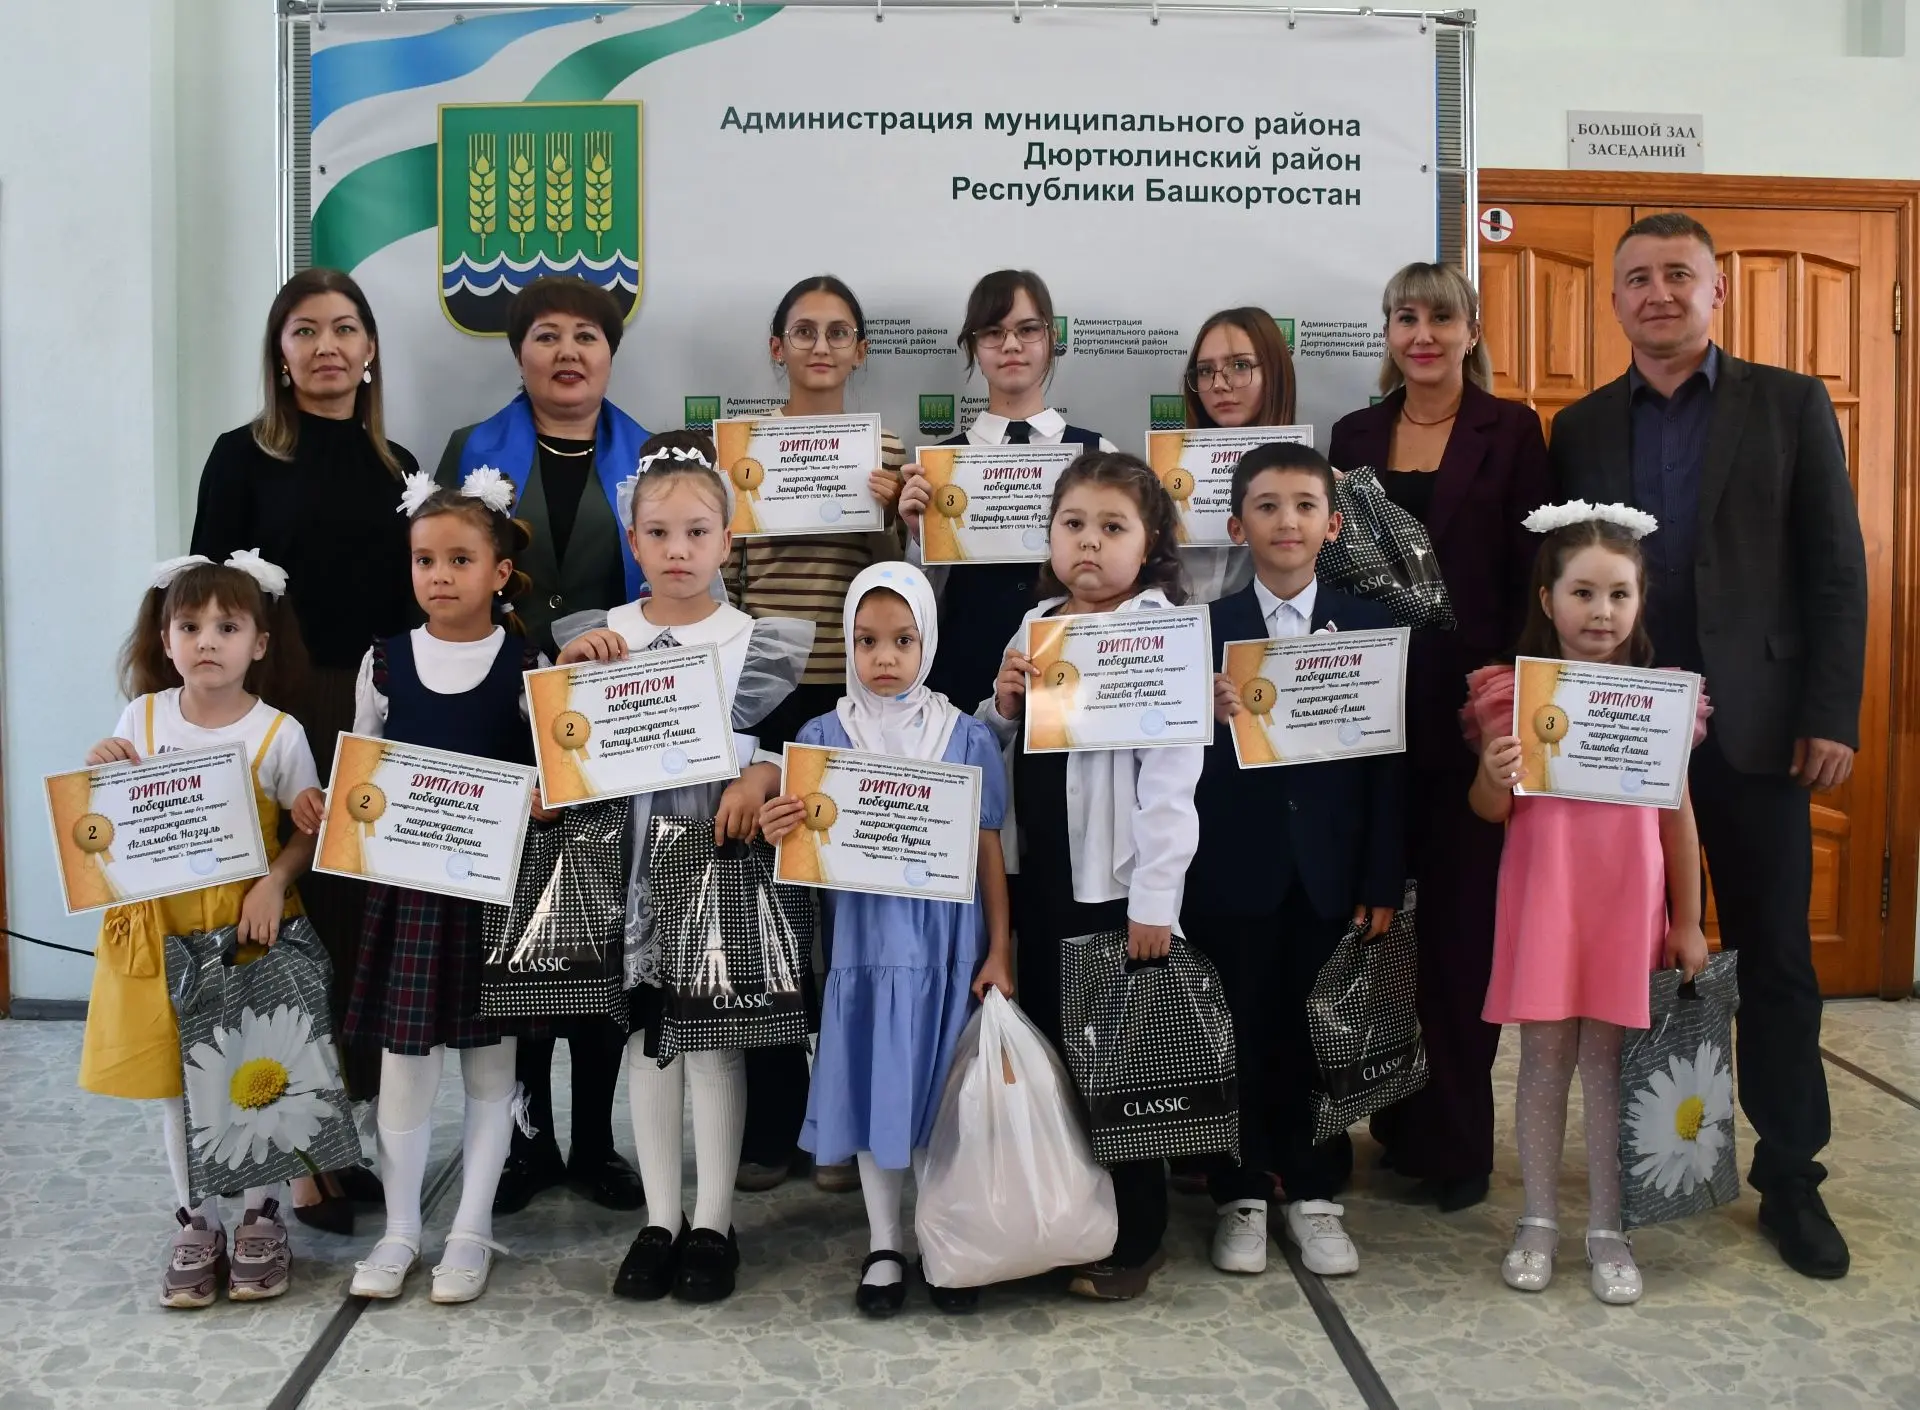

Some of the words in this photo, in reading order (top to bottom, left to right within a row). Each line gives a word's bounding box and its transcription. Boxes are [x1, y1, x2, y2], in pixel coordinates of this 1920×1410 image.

[720, 106, 972, 135] Администрация
[984, 112, 1244, 136] муниципального
[1255, 111, 1361, 139] района
[1578, 123, 1661, 137] БОЛЬШОЙ
[1667, 126, 1696, 138] ЗАЛ
[1024, 141, 1261, 171] Дюртюлинский
[1273, 146, 1361, 174] район
[1588, 143, 1686, 158] ЗАСЕДАНИЙ
[952, 176, 1134, 206] Республики
[1146, 178, 1361, 209] Башкортостан
[1073, 318, 1143, 326] Администрация
[1301, 320, 1368, 329] Администрация
[1149, 328, 1179, 337] района
[910, 337, 936, 346] район
[1073, 338, 1139, 346] Дюртюлинский
[1142, 338, 1168, 346] район
[1300, 339, 1365, 348] Дюртюлинский
[895, 347, 957, 356] Башкортостан
[1073, 347, 1124, 356] Республики
[1126, 348, 1188, 356] Башкортостан
[1301, 350, 1350, 358] Республики
[1352, 350, 1383, 358] Башкор
[779, 438, 840, 452] ДИПЛОМ
[781, 454, 839, 465] победителя
[1211, 451, 1242, 463] ДИП
[745, 468, 750, 479] 1
[783, 475, 839, 484] награждается
[983, 467, 1042, 480] ДИПЛОМ
[984, 482, 1042, 493] победителя
[1174, 478, 1181, 489] 3
[947, 495, 955, 507] 3
[1097, 636, 1164, 653] ДИПЛОМ
[1098, 655, 1164, 668] победителя
[1295, 654, 1362, 670] ДИПЛОМ
[1056, 672, 1065, 685] 2
[1296, 671, 1360, 683] победителя
[605, 675, 675, 700] ДИПЛОМ
[1100, 680, 1164, 691] награждается
[1134, 689, 1166, 698] Амина
[1254, 689, 1263, 702] 3
[1297, 693, 1358, 705] награждается
[1588, 690, 1653, 709] ДИПЛОМ
[608, 694, 677, 712] победителя
[1588, 708, 1651, 722] победителя
[566, 722, 574, 737] 2
[613, 719, 680, 735] награждается
[1546, 716, 1555, 730] 3
[662, 727, 696, 740] Амина
[1588, 731, 1648, 743] награждается
[128, 774, 201, 801] ДИПЛОМ
[411, 773, 485, 798] ДИПЛОМ
[859, 778, 932, 799] ДИПЛОМ
[132, 793, 205, 814] победителя
[359, 794, 371, 810] 2
[409, 791, 480, 812] победителя
[859, 796, 929, 812] победителя
[814, 804, 821, 818] 1
[139, 815, 208, 834] награждается
[405, 817, 475, 835] награждается
[860, 819, 928, 833] награждается
[88, 825, 97, 841] 2
[127, 832, 178, 851] Аглямова
[180, 825, 221, 839] Назгуль
[444, 832, 482, 848] Дарина
[853, 829, 898, 842] Закирова
[901, 834, 931, 847] Нурия
[508, 956, 570, 973] CLASSIC
[713, 991, 773, 1009] CLASSIC
[1124, 1097, 1190, 1116] CLASSIC
